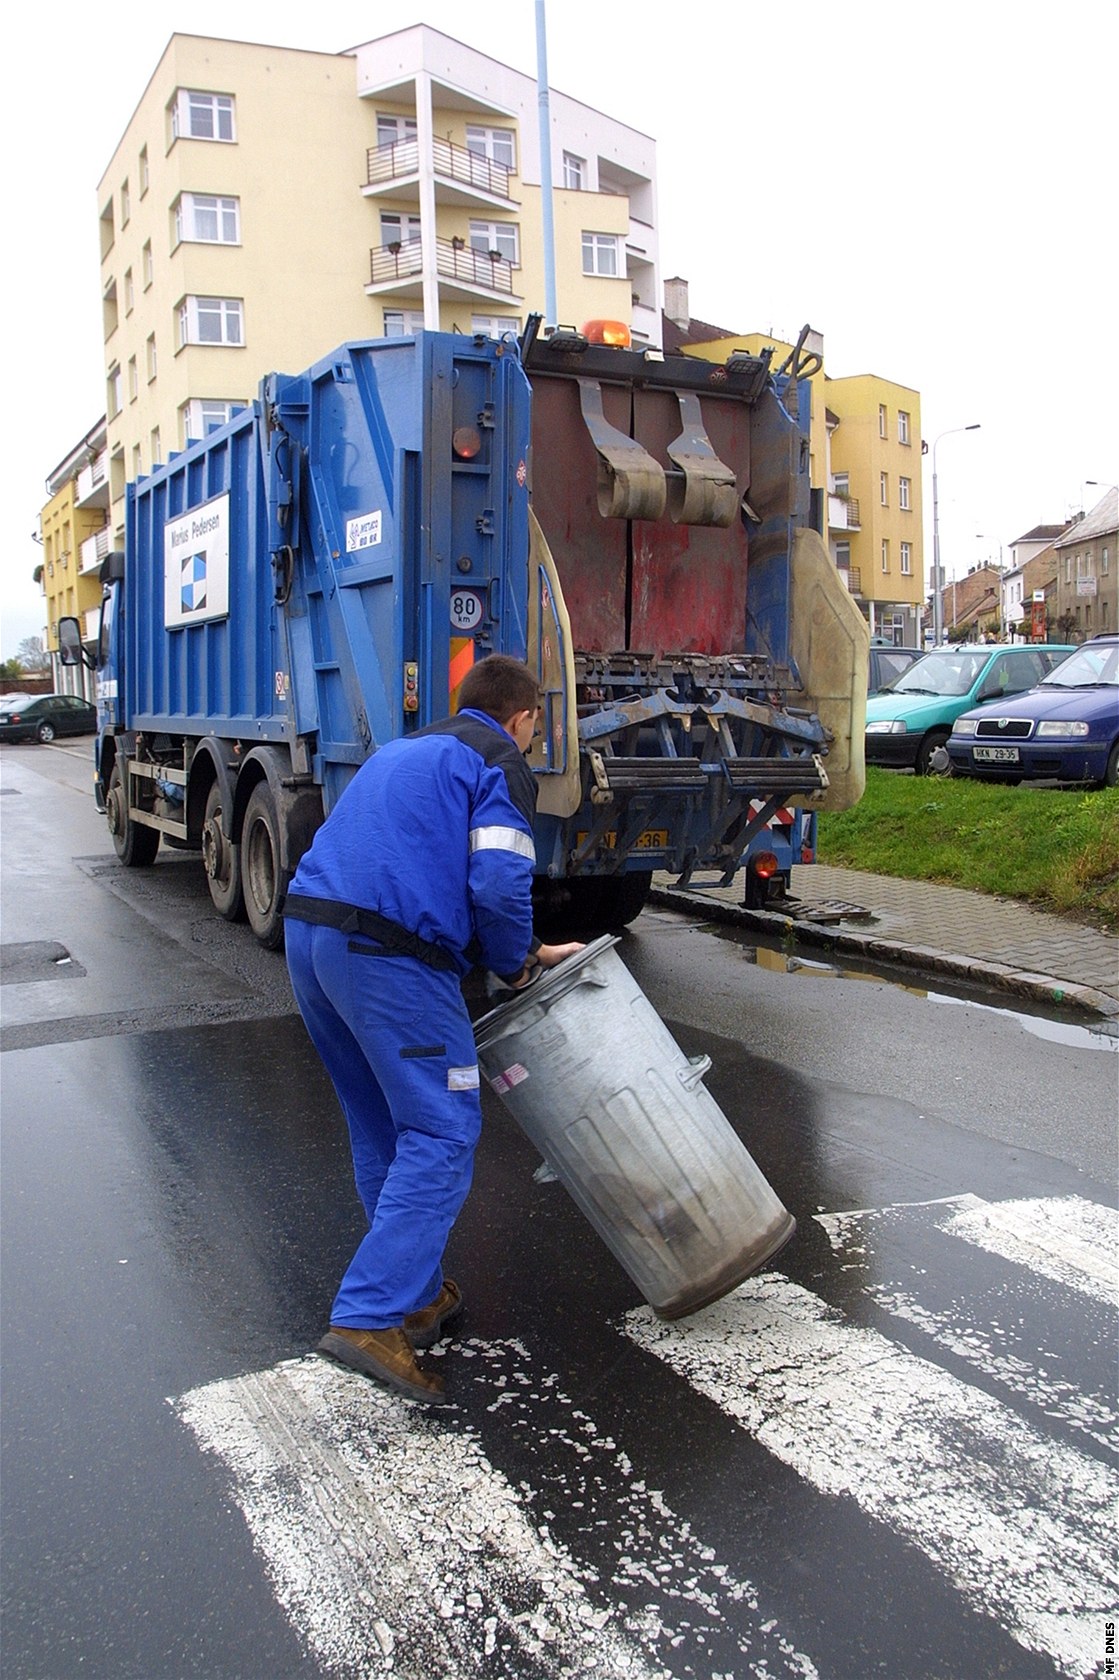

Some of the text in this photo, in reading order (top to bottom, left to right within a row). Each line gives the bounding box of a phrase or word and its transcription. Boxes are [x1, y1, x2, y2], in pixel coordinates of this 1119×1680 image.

[171, 514, 220, 548] Marius Pedersen
[454, 597, 475, 615] 80
[458, 614, 471, 622] km
